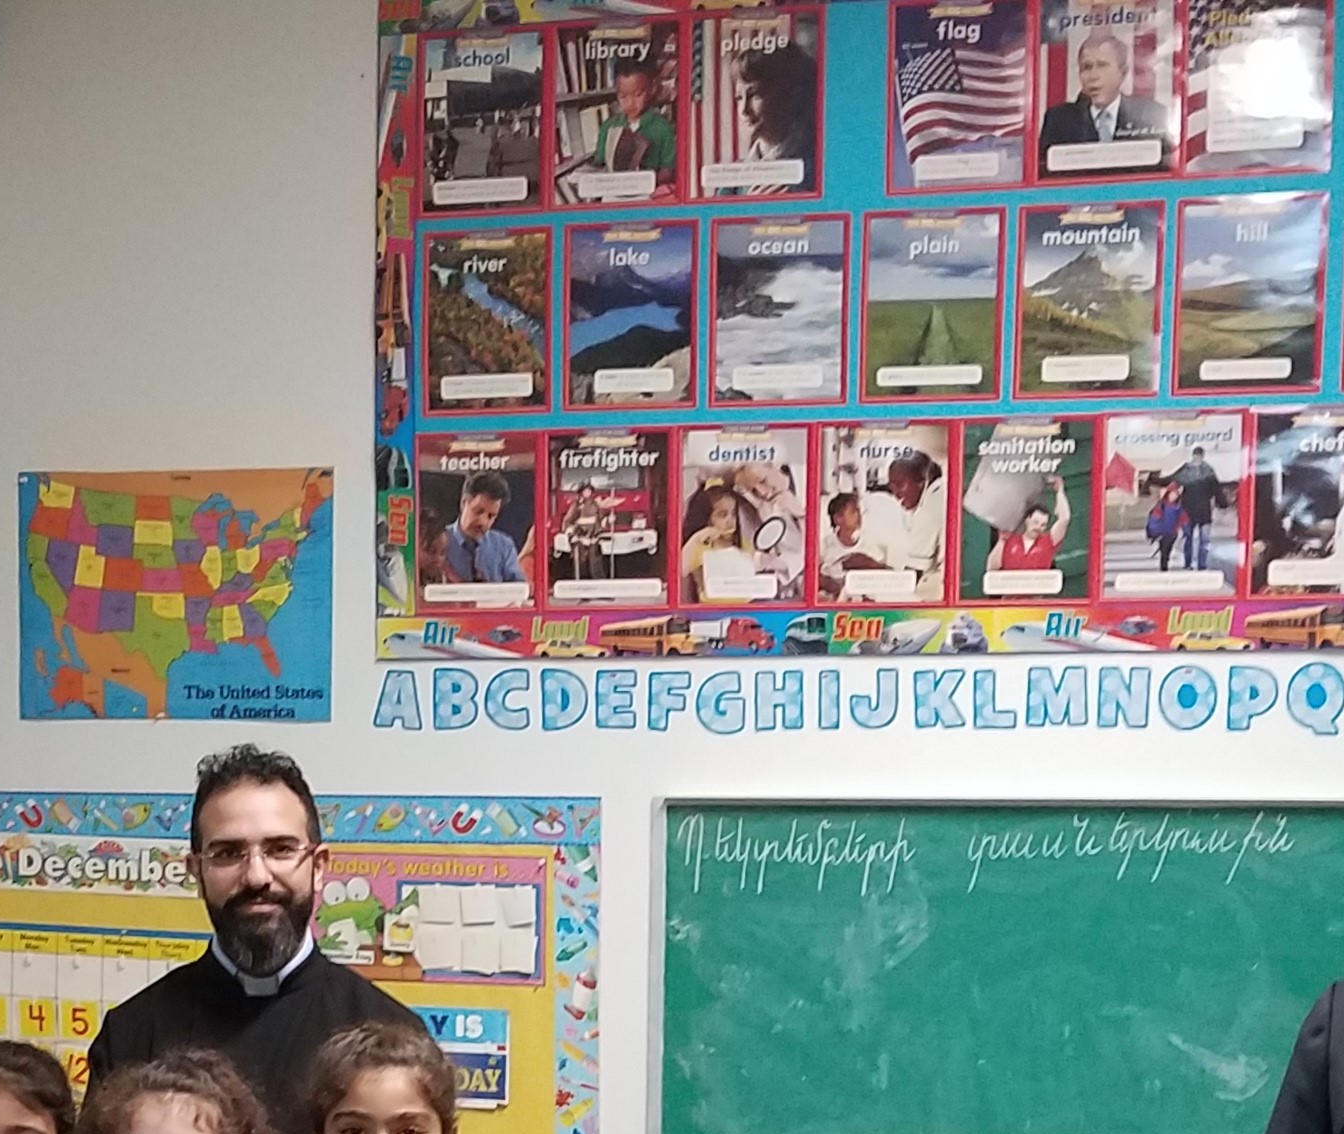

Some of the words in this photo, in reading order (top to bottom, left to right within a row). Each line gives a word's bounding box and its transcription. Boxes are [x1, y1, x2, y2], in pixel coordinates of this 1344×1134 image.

[936, 19, 981, 43] flag
[585, 40, 650, 62] library
[721, 32, 788, 57] pledge
[456, 47, 510, 68] school
[1042, 224, 1141, 247] mountain
[1235, 221, 1268, 243] hill
[609, 247, 651, 268] lake
[748, 237, 810, 256] ocean
[909, 234, 960, 260] plain
[462, 254, 508, 274] river
[978, 435, 1076, 456] sanitation
[1114, 429, 1181, 447] crossing
[1183, 427, 1233, 446] guard
[439, 451, 511, 472] teacher
[558, 446, 660, 472] firefighter
[708, 444, 777, 463] dentist
[859, 445, 915, 460] nurse
[992, 455, 1062, 474] worker
[422, 619, 461, 649] Air
[832, 611, 886, 642] Sea
[1043, 610, 1089, 639] Air
[183, 684, 215, 700] The
[218, 684, 273, 700] United
[275, 684, 324, 701] States
[211, 704, 228, 719] of
[229, 703, 296, 720] America
[18, 845, 197, 885] Decembe
[405, 858, 486, 877] weather
[29, 1004, 46, 1032] 4
[72, 1007, 90, 1036] 5
[455, 1013, 485, 1039] IS
[66, 1053, 90, 1085] 12
